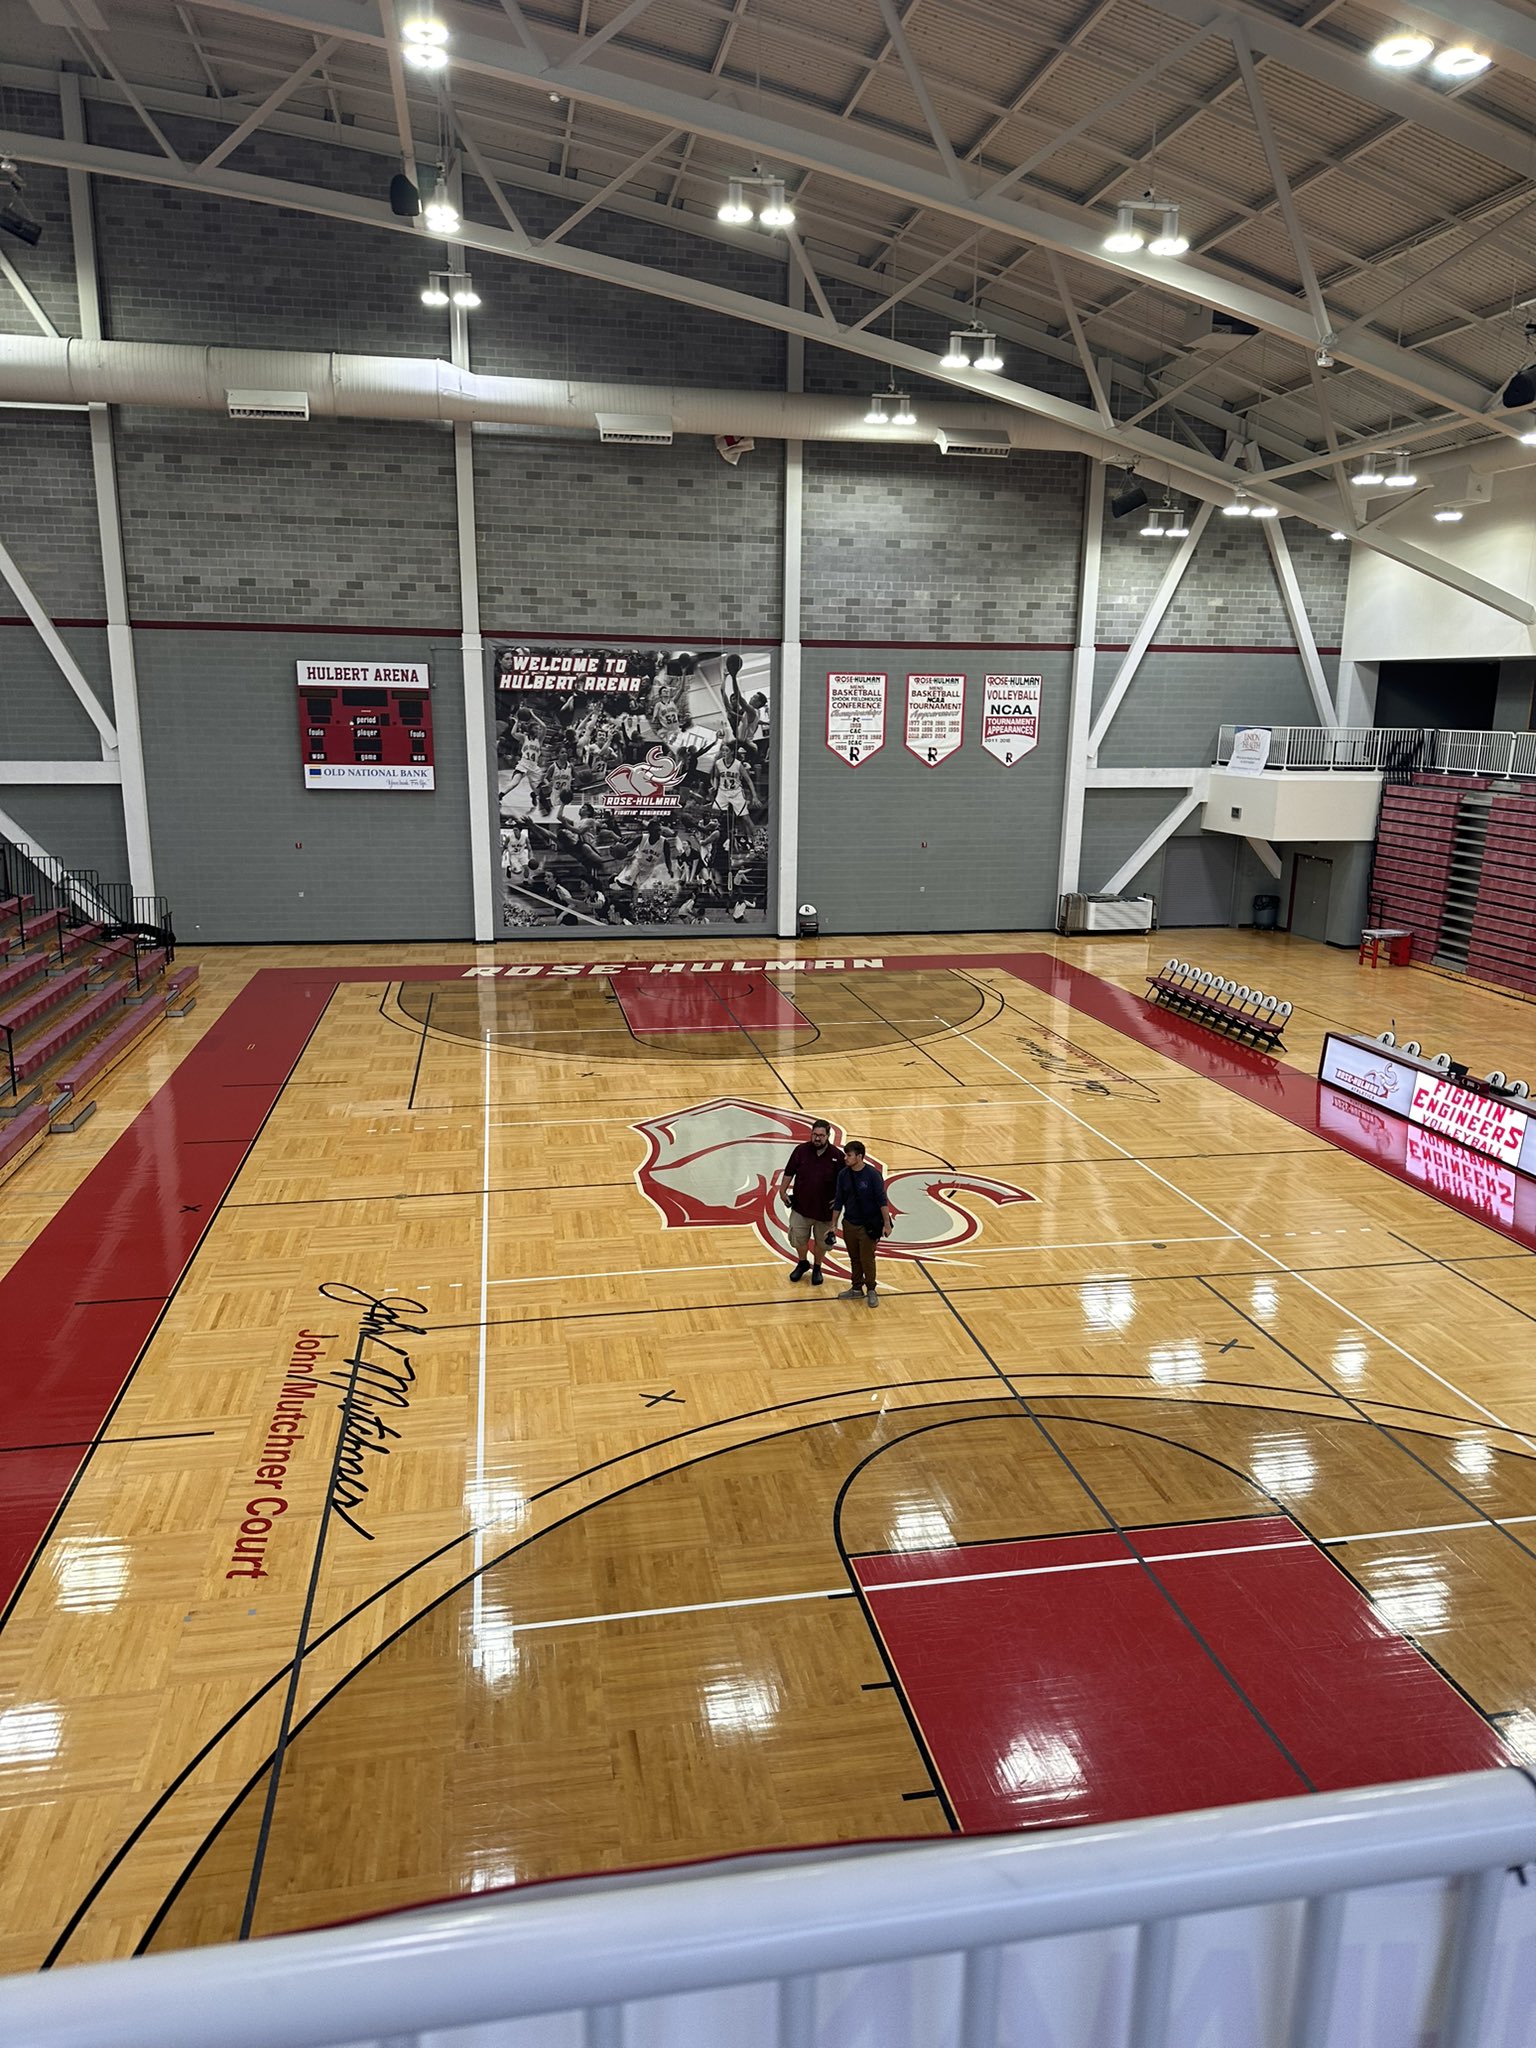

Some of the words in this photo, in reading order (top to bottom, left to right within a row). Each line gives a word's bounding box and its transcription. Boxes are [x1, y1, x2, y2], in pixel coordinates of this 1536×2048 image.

[513, 656, 599, 672] WELCOME
[605, 658, 627, 673] TO
[306, 666, 369, 681] HULBERT
[374, 668, 419, 682] ARENA
[499, 674, 577, 690] HULBERT
[584, 676, 641, 692] ARENA
[987, 677, 1040, 686] ROSE-HULMAN
[987, 690, 1038, 700] VOLLEYBALL
[991, 704, 1032, 715] NCAA
[356, 716, 377, 725] period
[665, 713, 677, 725] 52
[356, 728, 378, 738] player
[987, 725, 1034, 736] APPEARANCES
[360, 753, 377, 762] game
[849, 747, 860, 761] R
[927, 747, 938, 762] R
[1005, 752, 1013, 763] R
[323, 768, 346, 777] OLD
[348, 769, 398, 777] NATIONAL
[400, 769, 428, 777] BANK
[606, 796, 677, 806] ROSE-HULMAN
[461, 958, 885, 978] ROSE-HULMAN
[1382, 1034, 1390, 1044] R
[1407, 1043, 1415, 1053] R
[1437, 1055, 1445, 1067] R
[1336, 1070, 1379, 1095] ROSE-HULMAN
[1491, 1073, 1499, 1085] R
[1433, 1079, 1514, 1124] FIGHTIN'
[1413, 1087, 1524, 1150] ENGINEERS
[1422, 1113, 1504, 1158] VOLLEYBALL
[286, 1329, 326, 1374] John
[253, 1382, 319, 1490] Mutchner
[225, 1496, 289, 1579] Court
